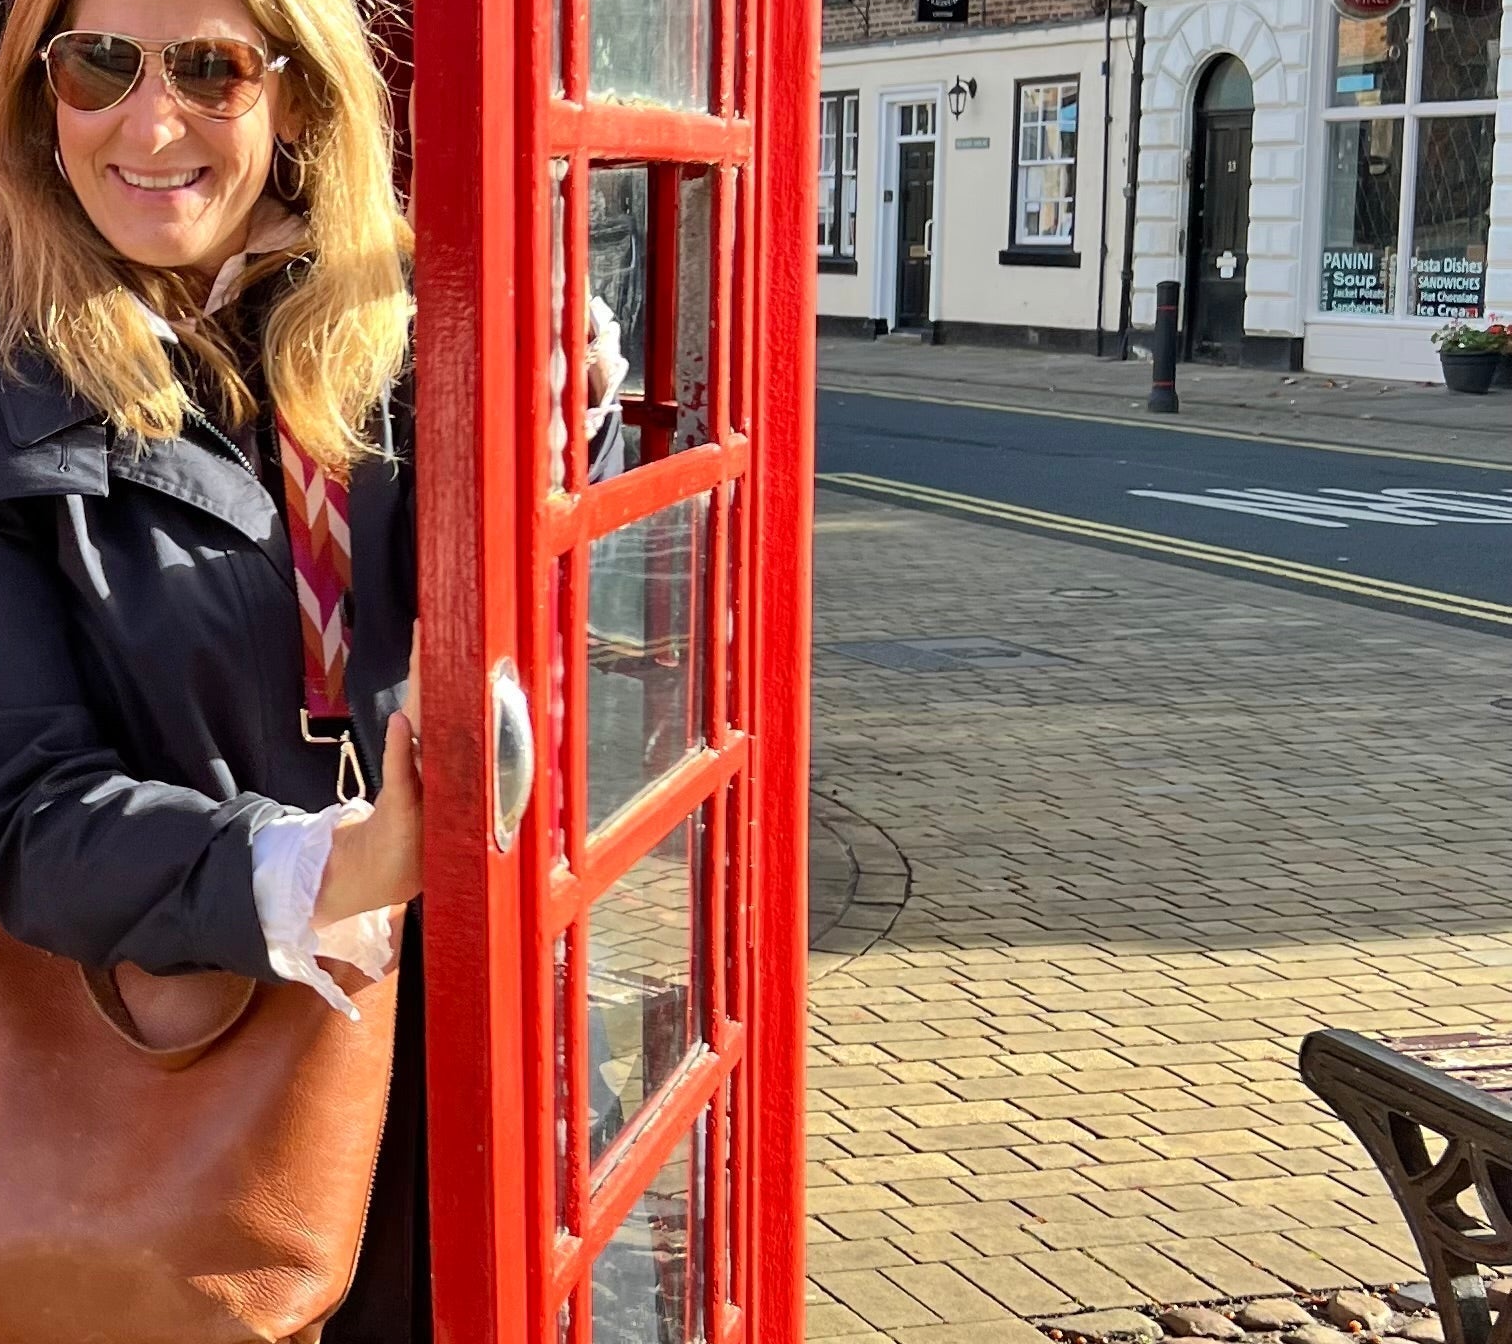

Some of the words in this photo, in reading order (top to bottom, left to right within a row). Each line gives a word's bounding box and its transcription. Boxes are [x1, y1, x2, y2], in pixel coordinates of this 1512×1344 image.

[1323, 252, 1373, 269] PANINI
[1410, 257, 1441, 273] Pasta
[1443, 257, 1483, 274] Dishes
[1333, 270, 1377, 288] Soup
[1417, 275, 1480, 291] SANDWICHES
[1437, 290, 1479, 304] Chocolate
[1416, 303, 1435, 316] Ice
